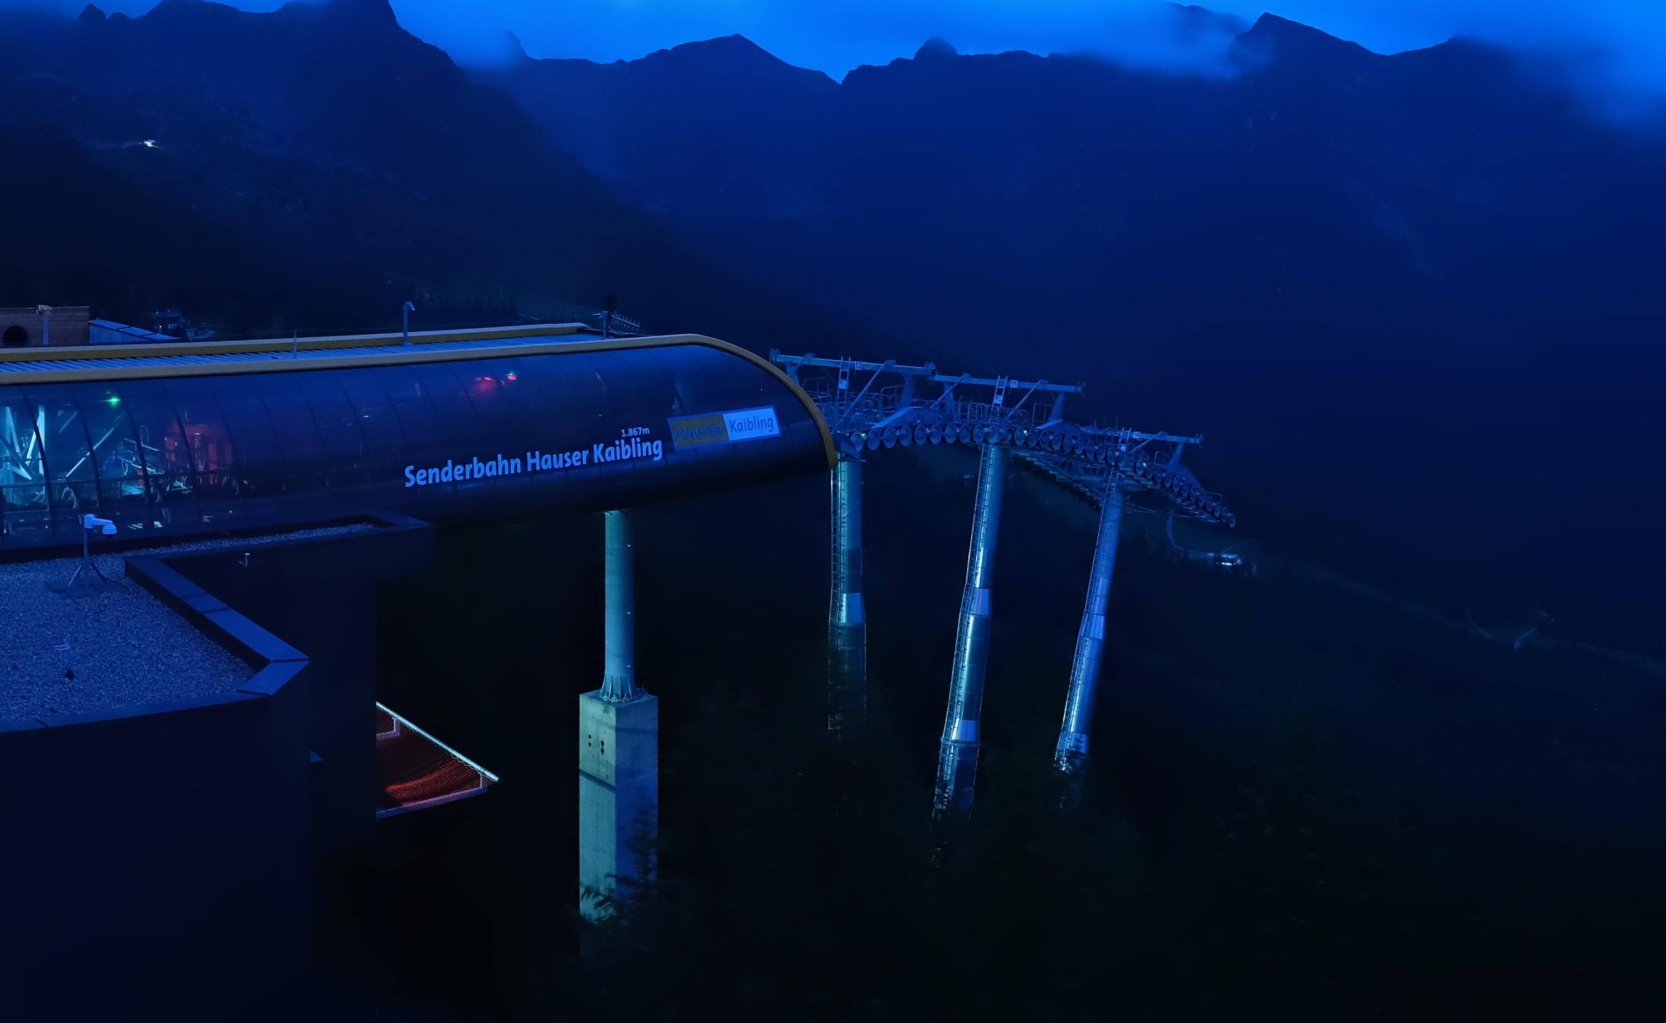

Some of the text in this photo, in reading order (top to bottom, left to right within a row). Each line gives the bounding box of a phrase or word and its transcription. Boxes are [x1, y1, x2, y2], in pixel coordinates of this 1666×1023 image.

[621, 427, 650, 438] 1.867m
[729, 417, 774, 434] Kaibling
[404, 437, 662, 488] Senderbahn Hauser Kaibling
